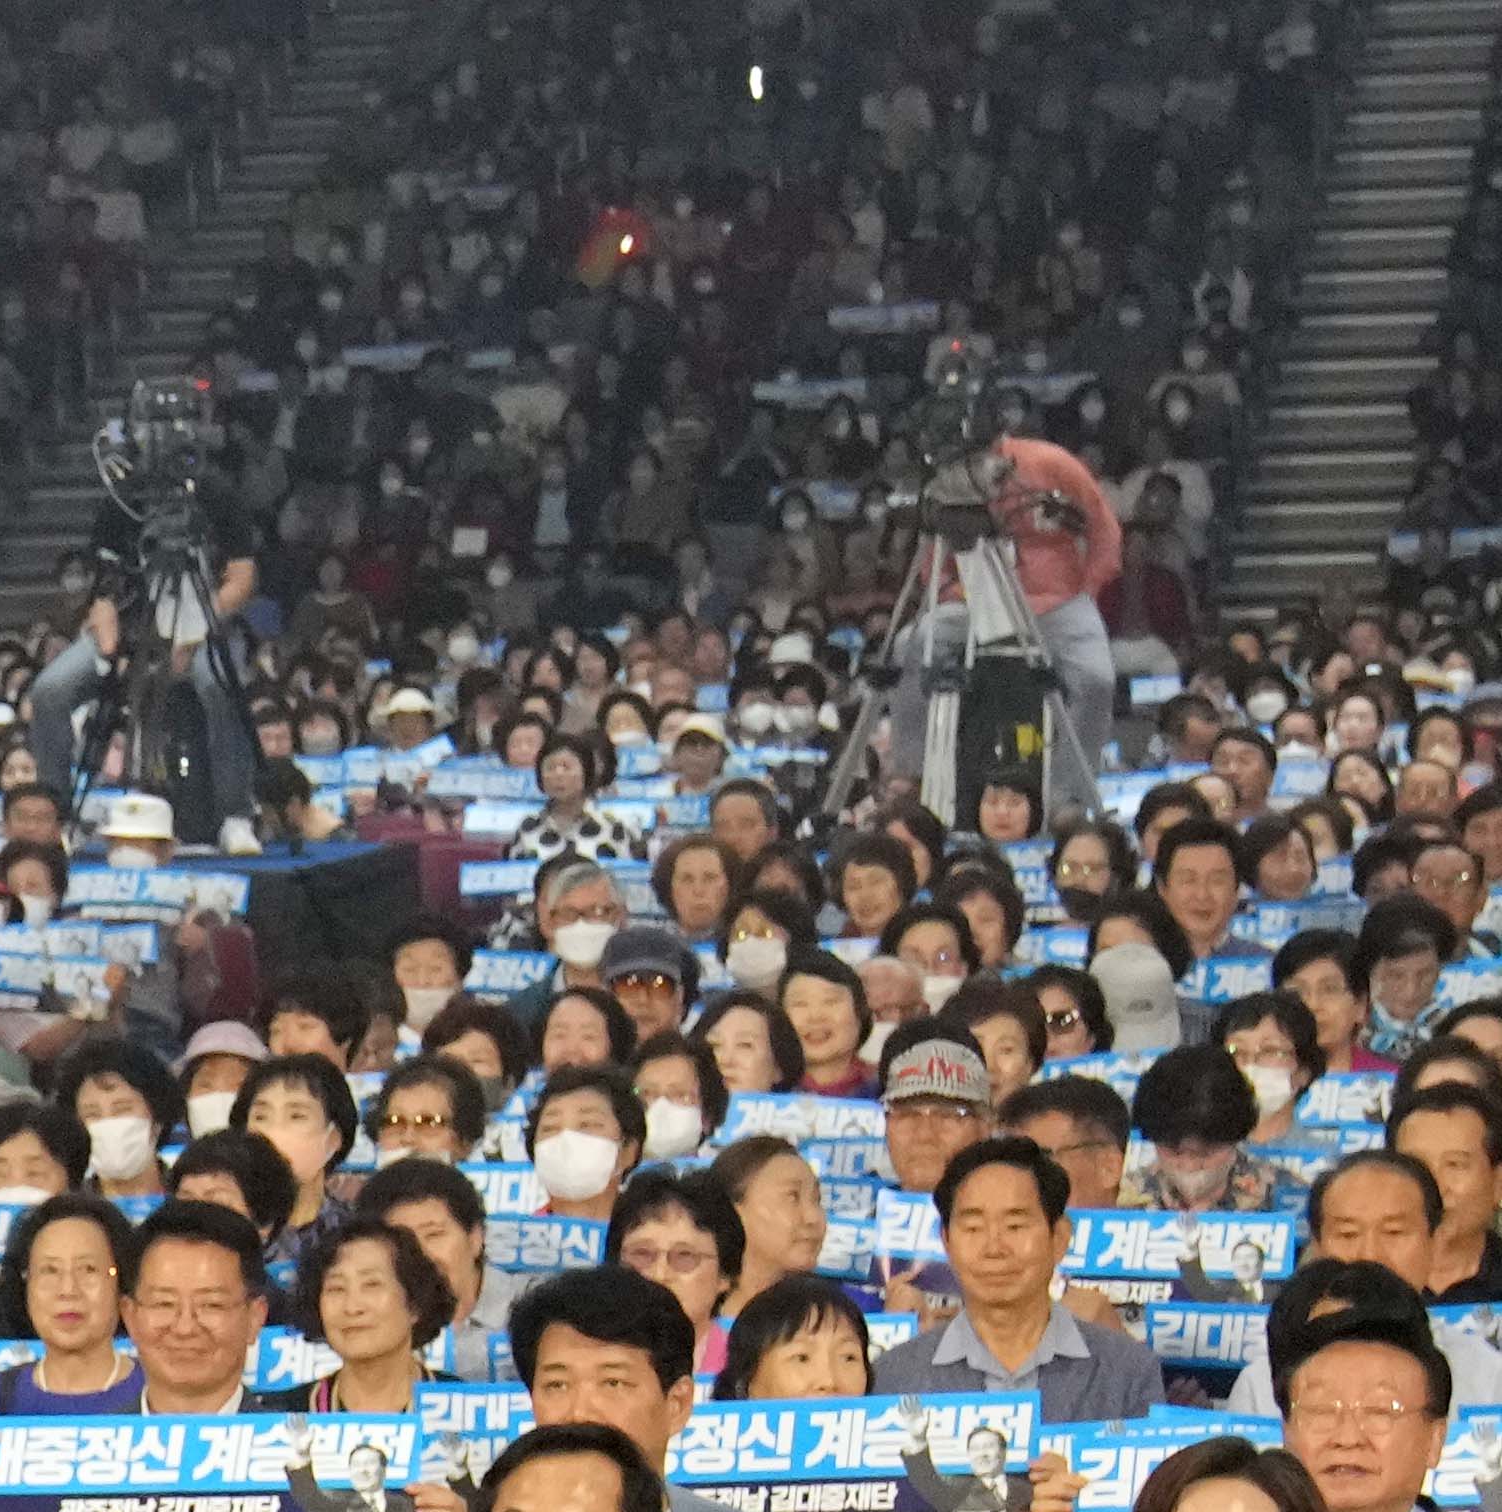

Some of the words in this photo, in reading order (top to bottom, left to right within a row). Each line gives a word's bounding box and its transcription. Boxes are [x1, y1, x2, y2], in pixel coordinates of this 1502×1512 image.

[1098, 1218, 1290, 1272] 계승발전
[195, 1420, 415, 1481] 계승발전
[805, 1399, 1030, 1468] 계승발전
